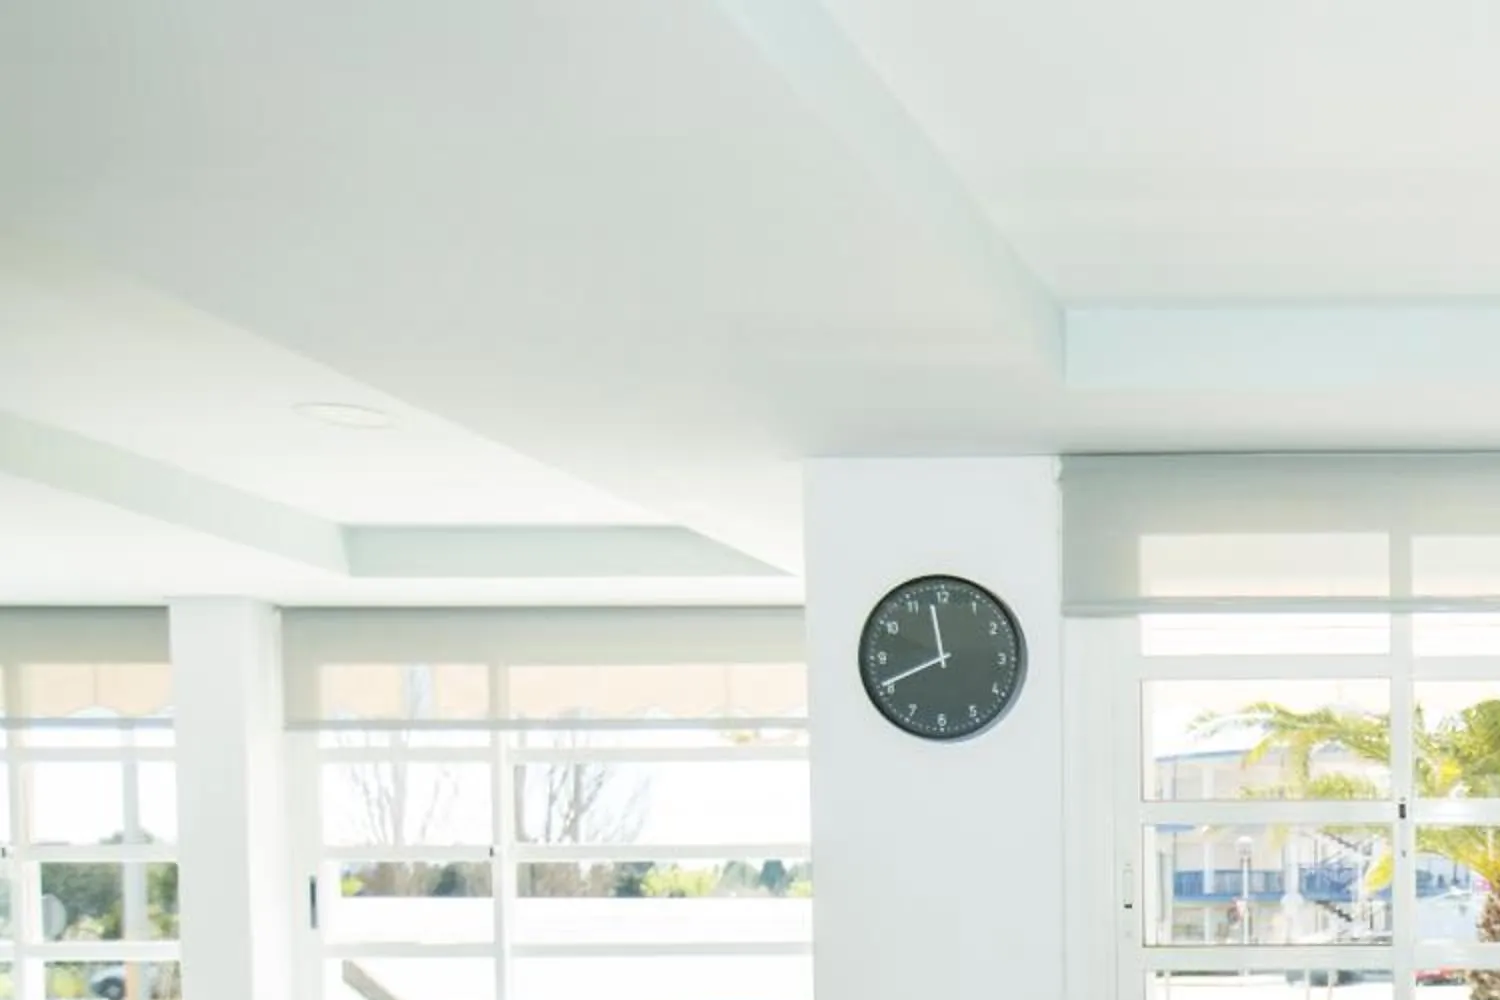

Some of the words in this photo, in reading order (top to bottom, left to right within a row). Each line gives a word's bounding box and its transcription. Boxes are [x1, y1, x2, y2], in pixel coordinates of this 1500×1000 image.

[936, 591, 949, 604] 12
[907, 601, 919, 615] 11
[887, 621, 899, 634] 10
[989, 622, 998, 635] 2
[998, 652, 1006, 665] 3
[991, 683, 999, 694] 4
[908, 703, 918, 717] 7
[969, 704, 977, 718] 5
[937, 713, 947, 727] 6
